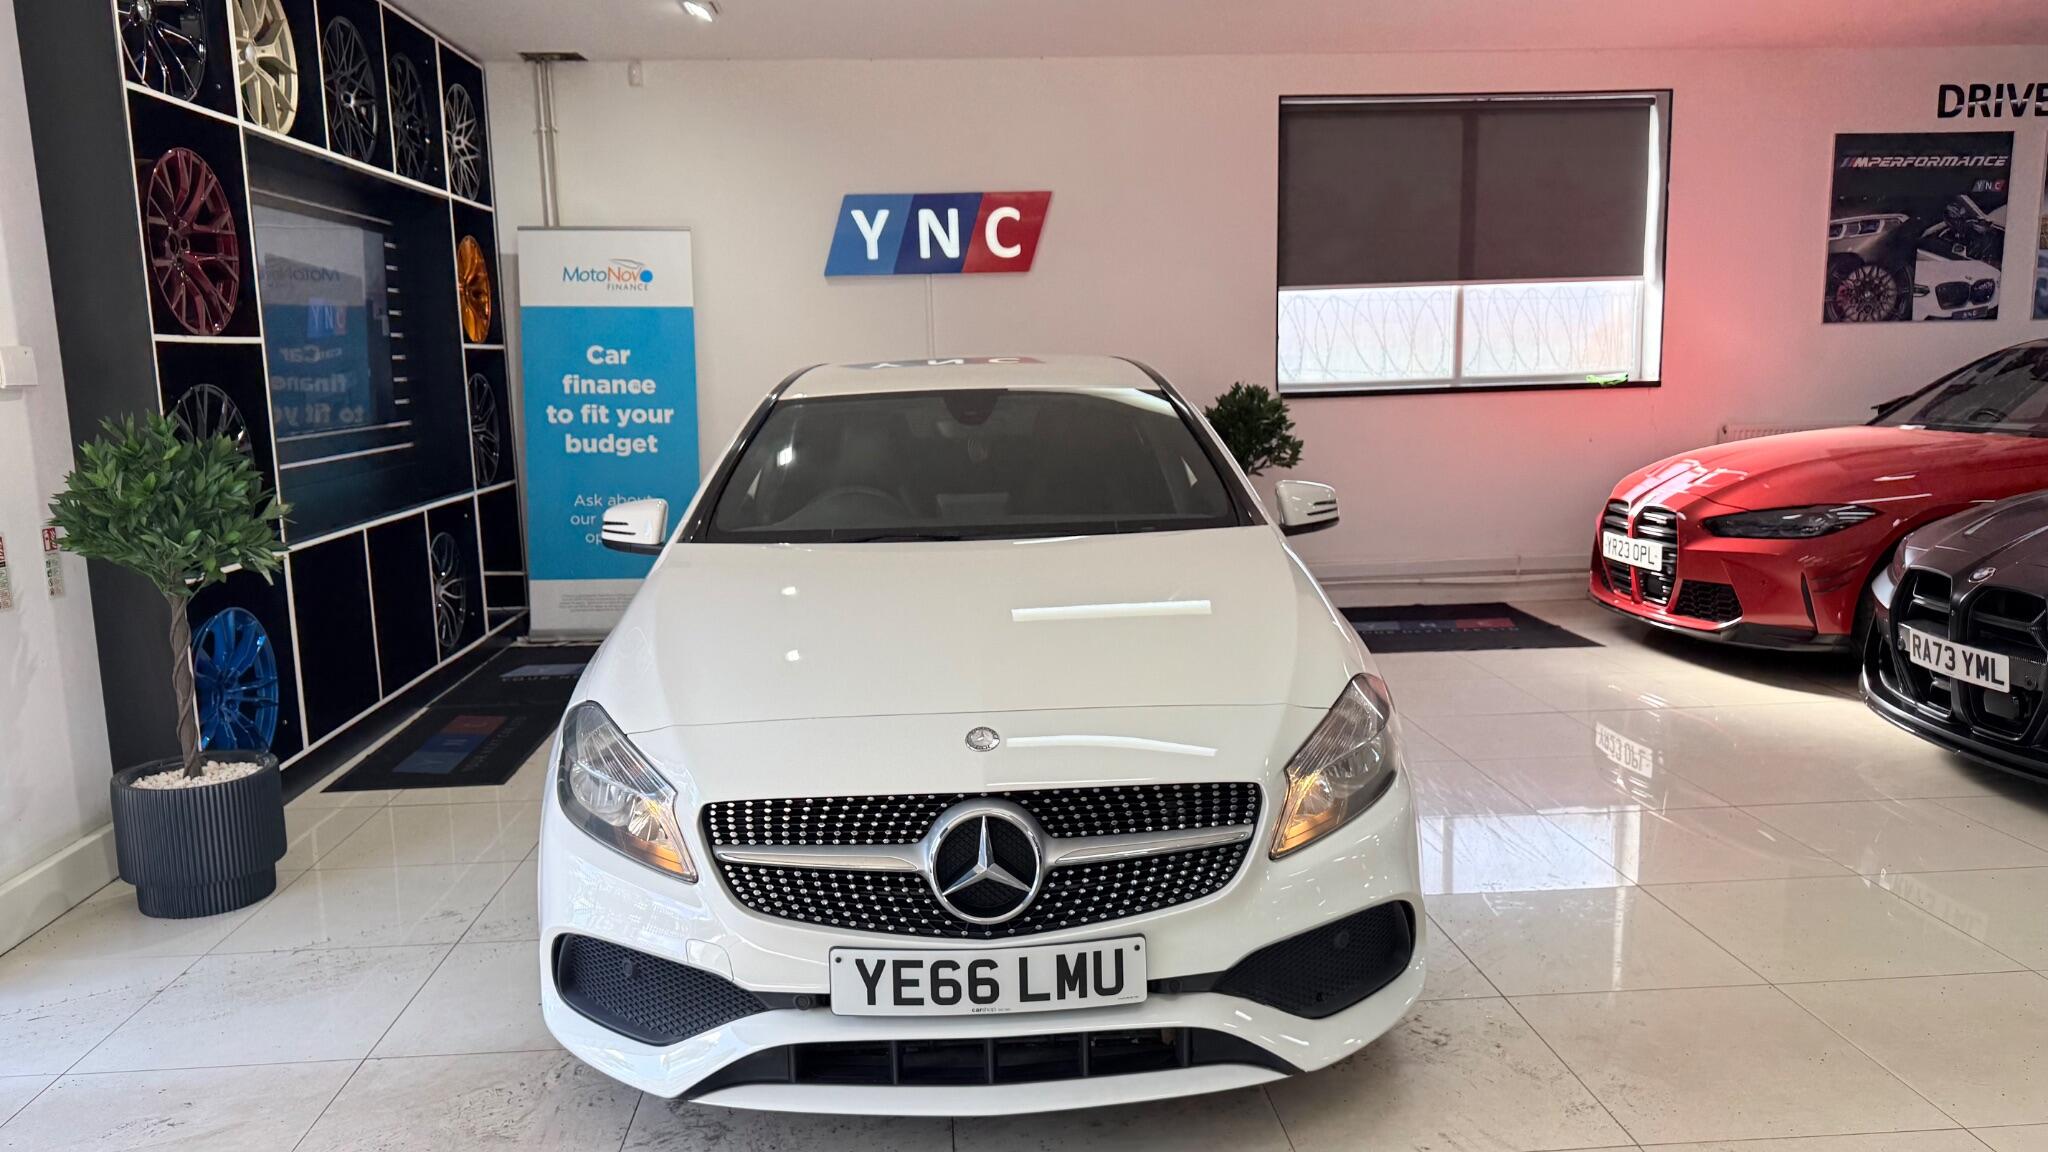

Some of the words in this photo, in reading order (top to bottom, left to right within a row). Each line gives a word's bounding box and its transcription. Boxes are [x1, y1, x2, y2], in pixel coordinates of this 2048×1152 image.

[851, 206, 1021, 260] YNC
[607, 283, 648, 291] FINANCE
[586, 345, 631, 365] Car
[562, 374, 656, 394] finance
[546, 404, 574, 424] to
[581, 404, 609, 424] fit
[616, 408, 674, 427] your
[565, 433, 658, 457] budget
[574, 493, 603, 507] Ask
[570, 515, 597, 526] our
[1606, 536, 1630, 559] YR23
[1632, 543, 1655, 566] OPL
[1912, 633, 1946, 672] RA73
[1961, 650, 2005, 687] YML
[854, 958, 1000, 1006] YE66
[1018, 948, 1124, 1003] LMU
